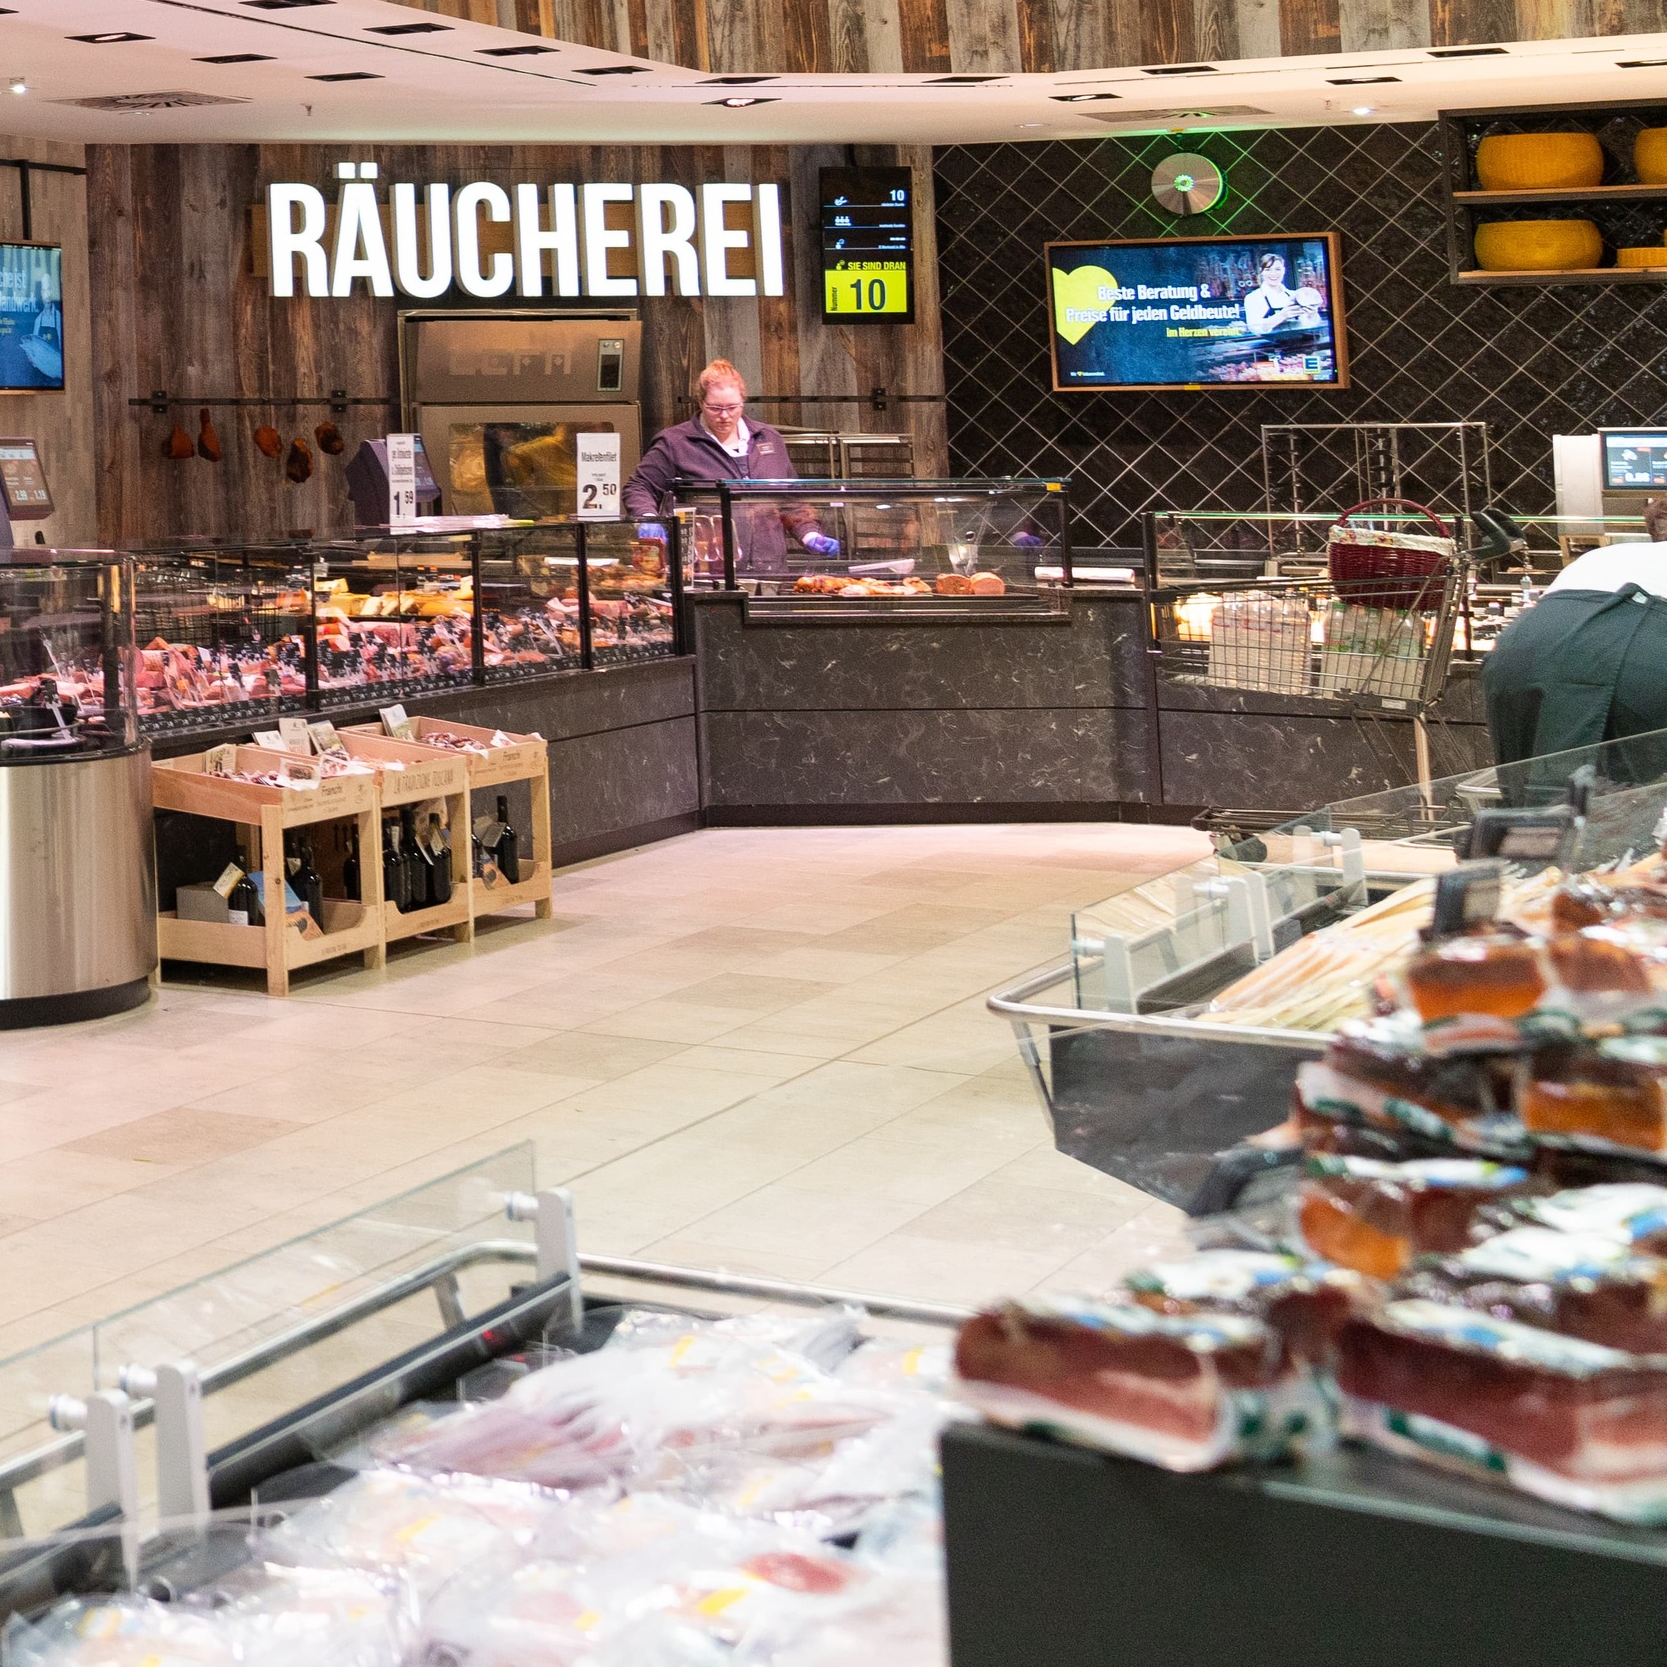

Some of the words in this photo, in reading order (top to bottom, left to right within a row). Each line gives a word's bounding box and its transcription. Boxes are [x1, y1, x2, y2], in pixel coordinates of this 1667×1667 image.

[889, 189, 905, 202] 10
[268, 162, 784, 297] RÄUCHEREI
[847, 261, 861, 271] SIE
[862, 261, 882, 271] SIND
[883, 261, 906, 271] DRAN
[830, 286, 838, 312] Nummer
[850, 278, 886, 311] 10
[1098, 285, 1135, 301] Beste
[1137, 284, 1198, 302] Beratung
[1200, 283, 1211, 298] &
[1066, 307, 1107, 322] Preise
[1109, 306, 1130, 322] für
[1131, 305, 1168, 324] jeden
[1179, 328, 1208, 337] Herzen
